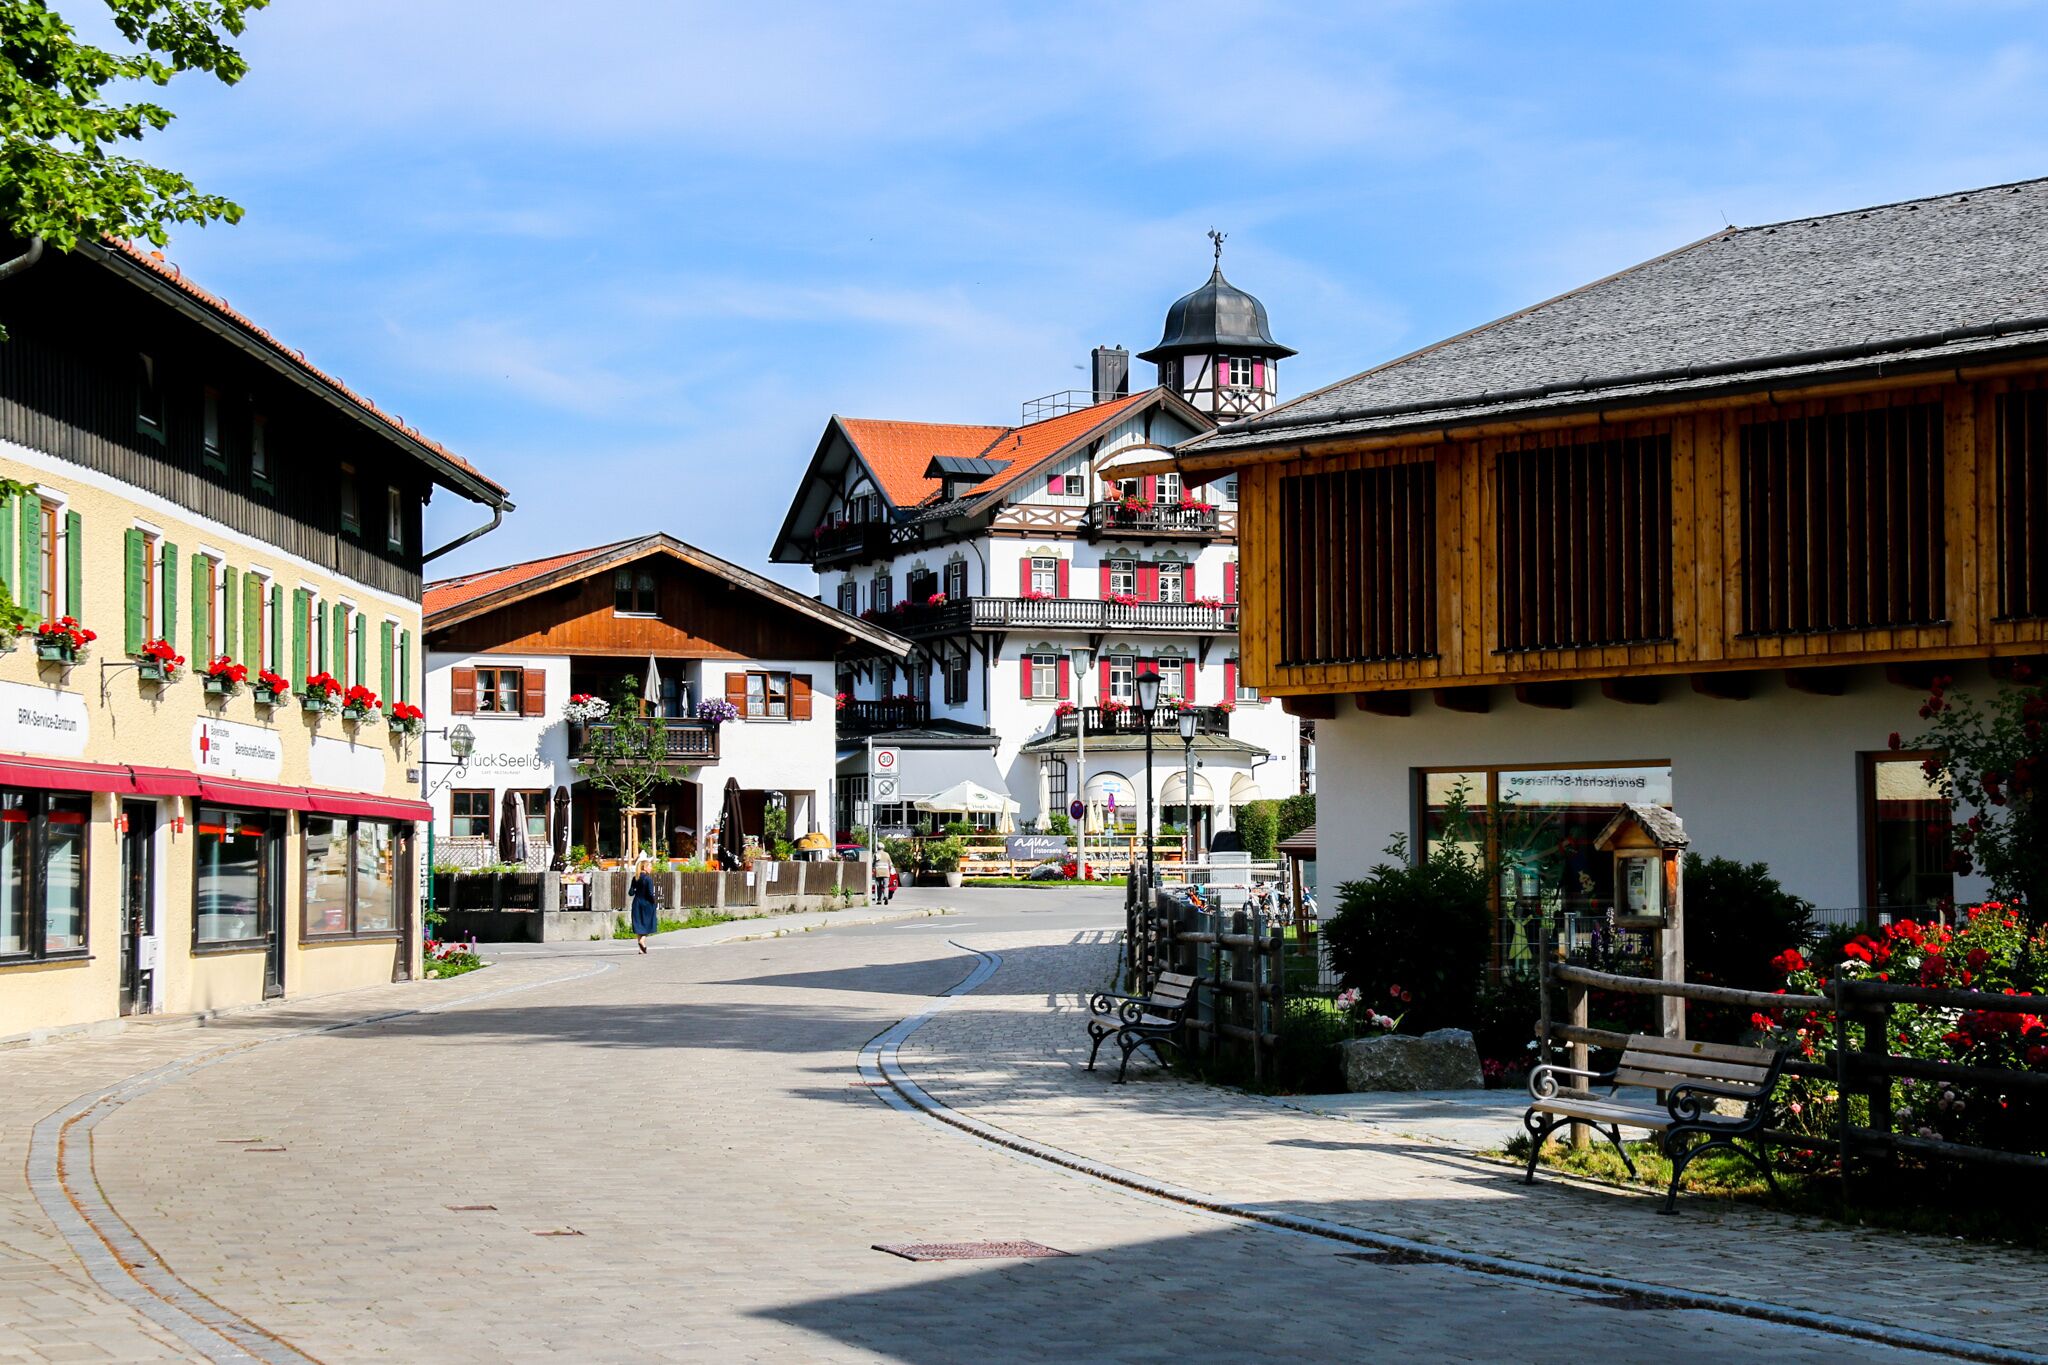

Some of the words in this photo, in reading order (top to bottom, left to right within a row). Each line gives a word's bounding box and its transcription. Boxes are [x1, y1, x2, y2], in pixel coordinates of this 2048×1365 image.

[18, 707, 77, 732] BRK-Service-Zentrum
[234, 741, 276, 760] Bereitschaft-Schliersee
[881, 755, 892, 764] 30
[1014, 837, 1055, 858] aqua
